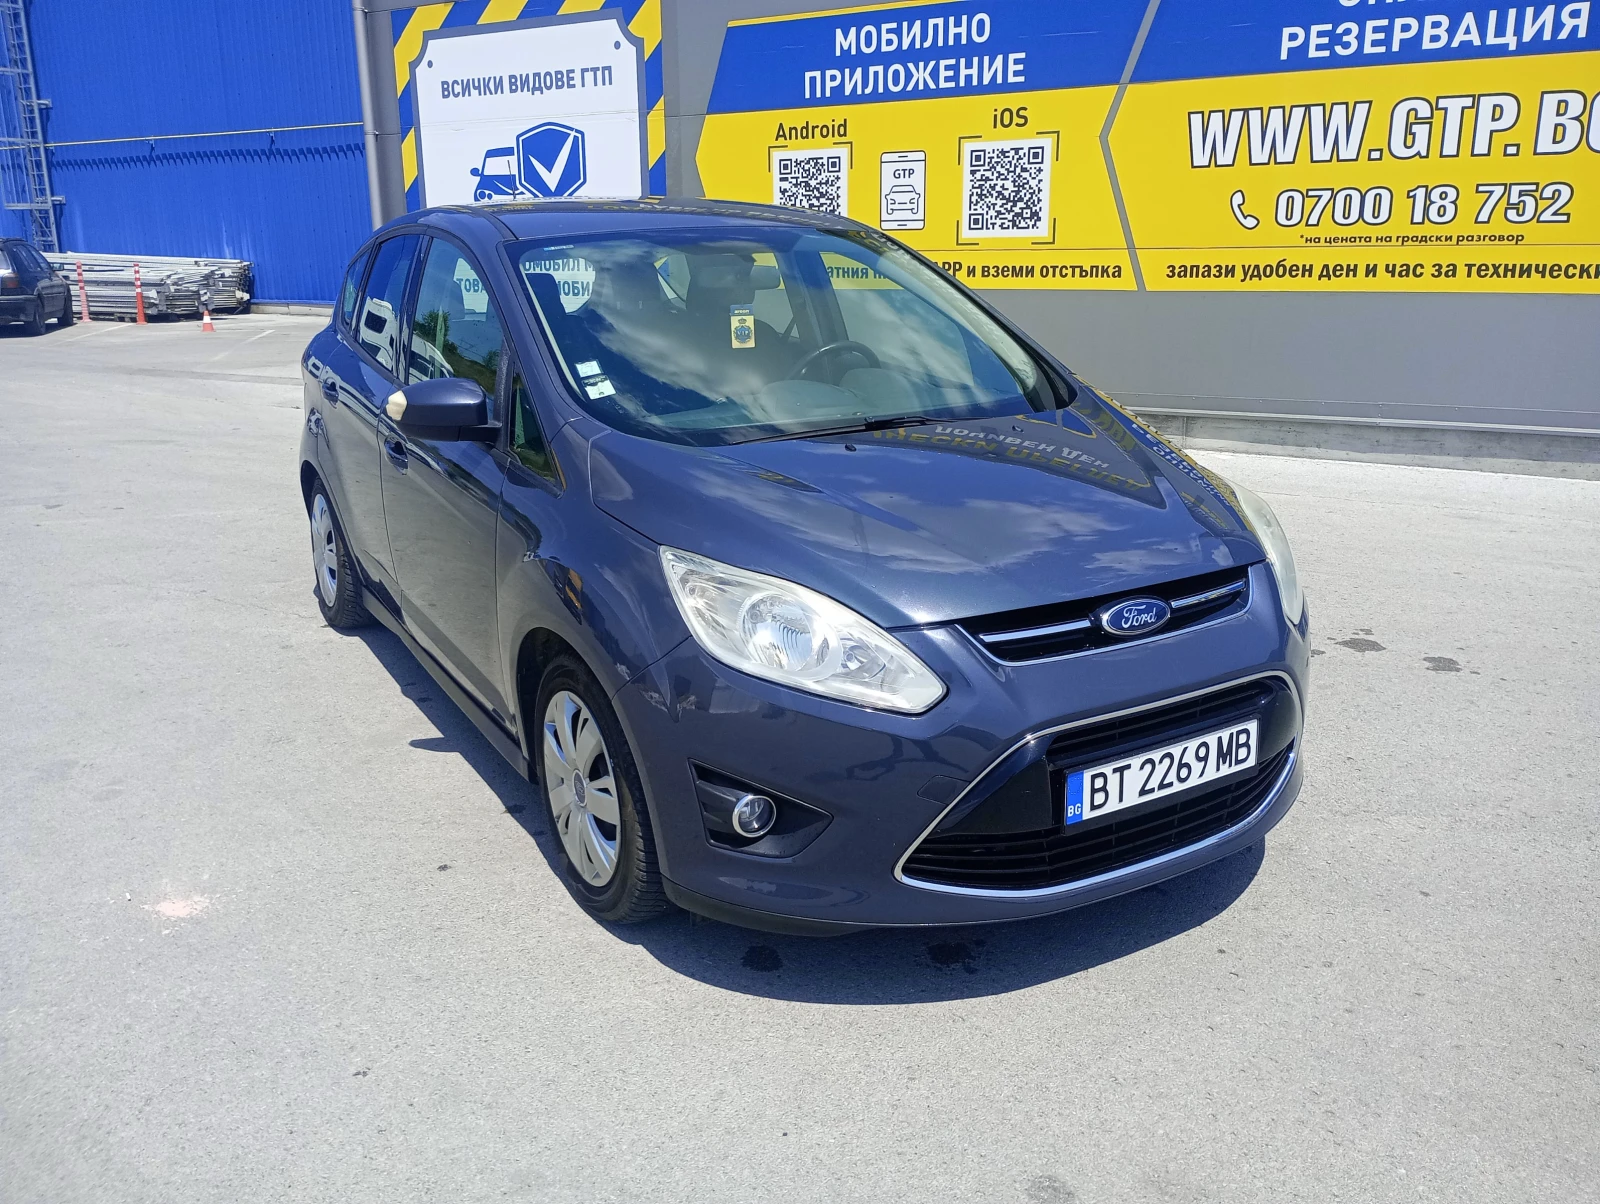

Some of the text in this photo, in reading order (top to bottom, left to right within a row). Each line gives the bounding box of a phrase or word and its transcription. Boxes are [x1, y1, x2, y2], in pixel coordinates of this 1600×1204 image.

[836, 13, 991, 57] МОБИЛНО
[1281, 2, 1591, 60] РЕЗЕРВАЦИЯ
[441, 66, 613, 99] ВСИЧКИ ВИДОВЕ ГТП
[805, 53, 1026, 99] ПРИЛОЖЕНИЕ
[993, 106, 1029, 129] iOS
[1188, 90, 1600, 168] WWW.GTP.B
[775, 118, 848, 141] Android
[893, 168, 915, 180] GTP
[1275, 182, 1574, 227] 0700 18 752
[1324, 235, 1373, 245] цената
[1375, 235, 1393, 244] на
[1395, 235, 1453, 245] градски
[1456, 233, 1525, 245] разговор
[967, 265, 976, 278] и
[981, 265, 1035, 279] вземи
[1040, 265, 1122, 279] отстъпка
[1166, 264, 1236, 279] запази
[1240, 259, 1314, 282] удобен
[1317, 264, 1359, 281] ден
[1364, 263, 1378, 279] и
[1385, 264, 1425, 279] час
[1430, 263, 1458, 279] за
[1121, 605, 1157, 628] Ford
[1089, 727, 1251, 811] BT 2269 MB
[1067, 803, 1082, 817] BG
